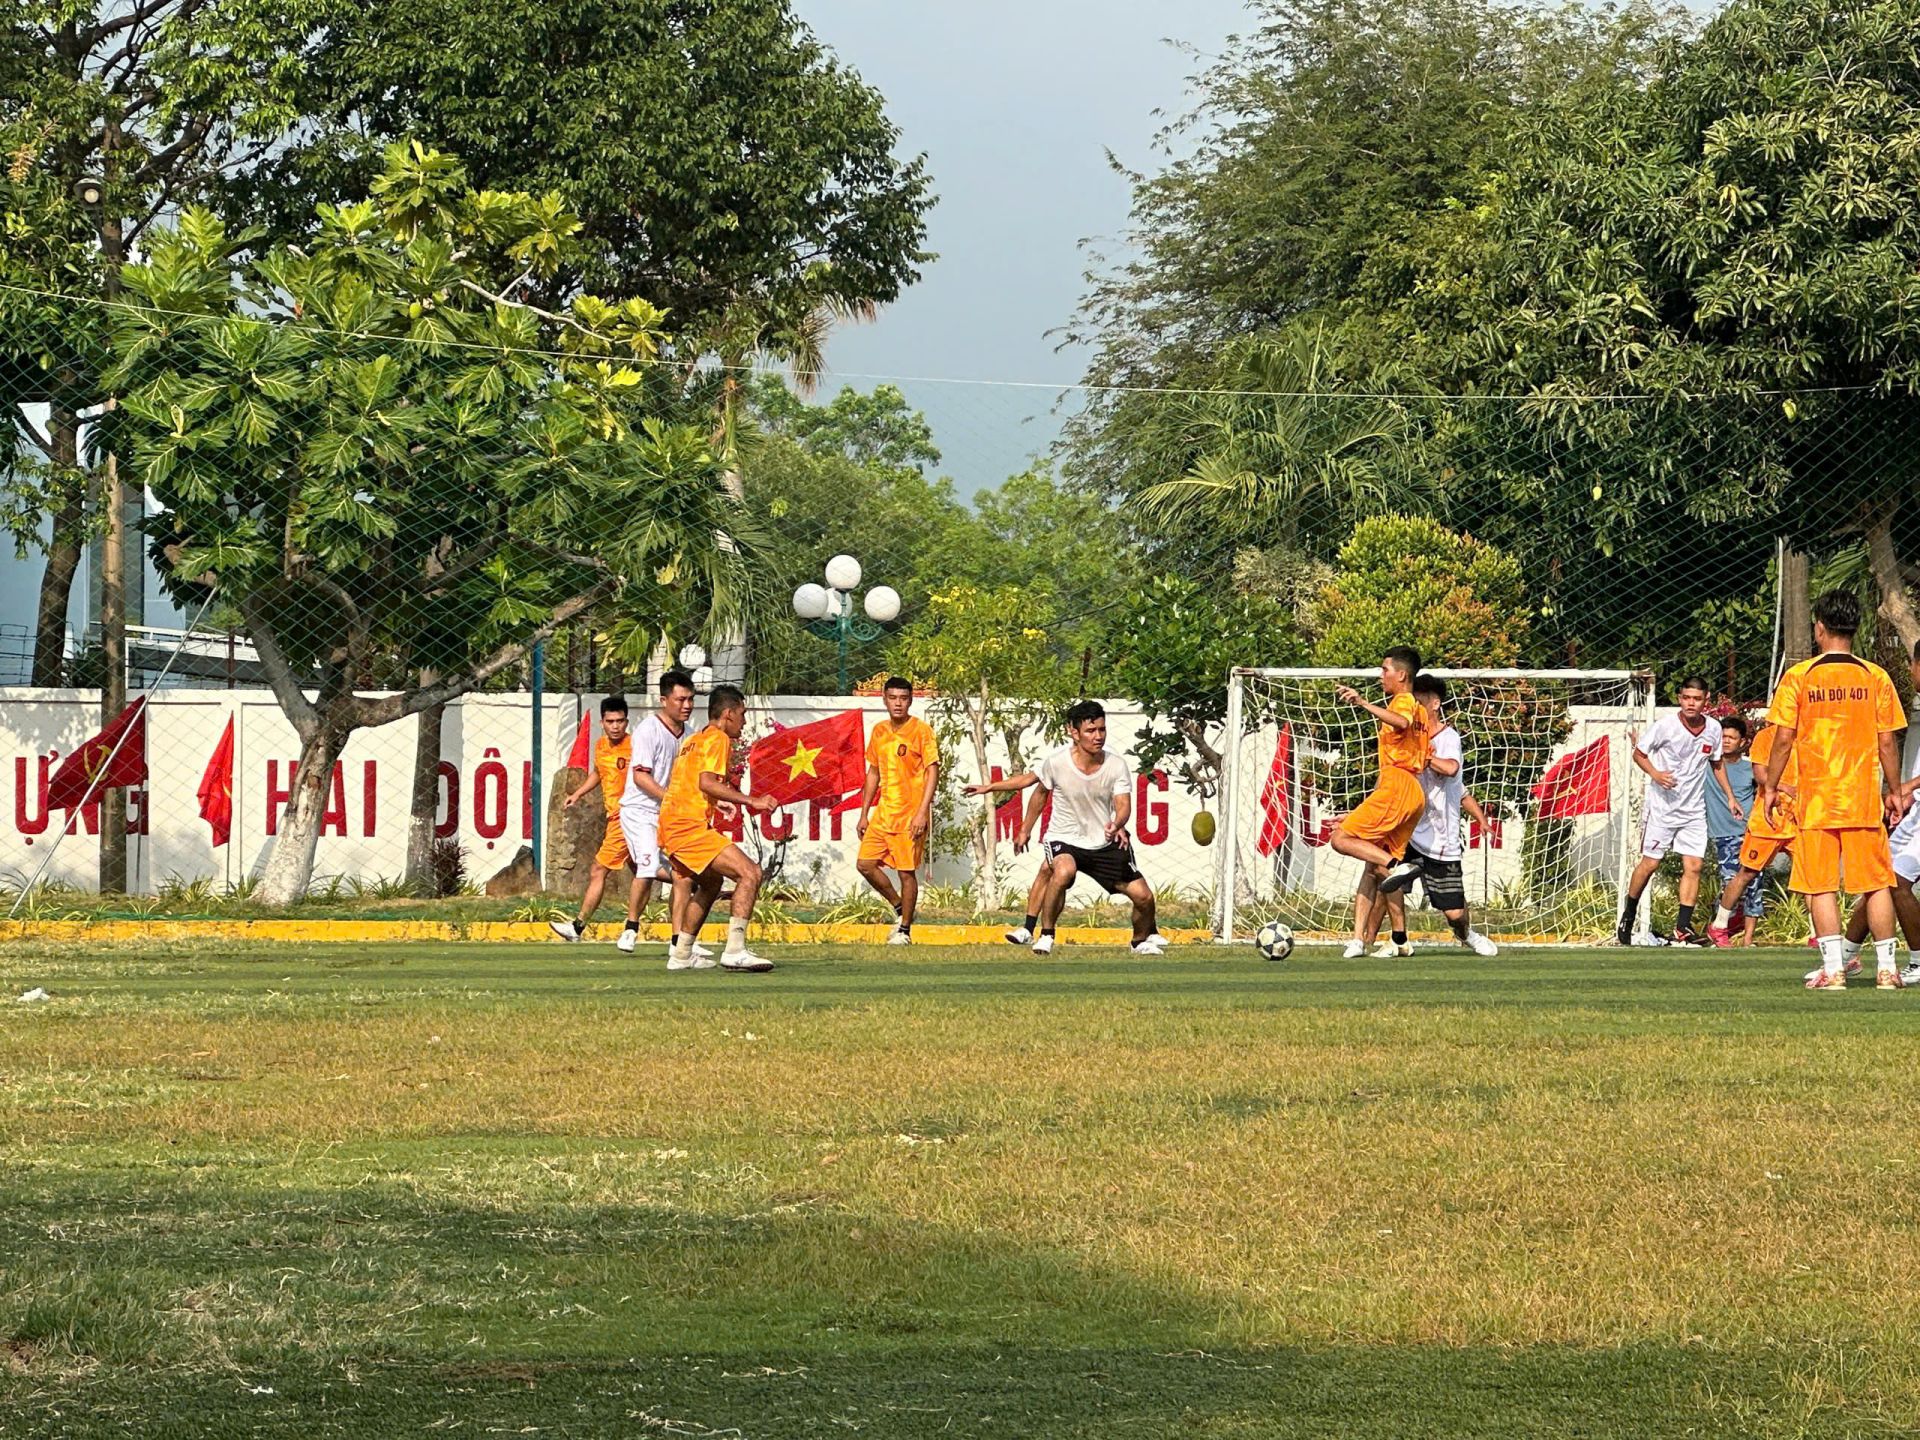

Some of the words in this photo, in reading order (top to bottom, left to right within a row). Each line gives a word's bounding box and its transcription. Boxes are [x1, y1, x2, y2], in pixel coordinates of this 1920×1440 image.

[1808, 684, 1825, 703] HẢI
[1829, 685, 1846, 704] ĐỘI
[1850, 687, 1868, 701] 401
[1652, 839, 1660, 850] 7
[642, 853, 651, 867] 3
